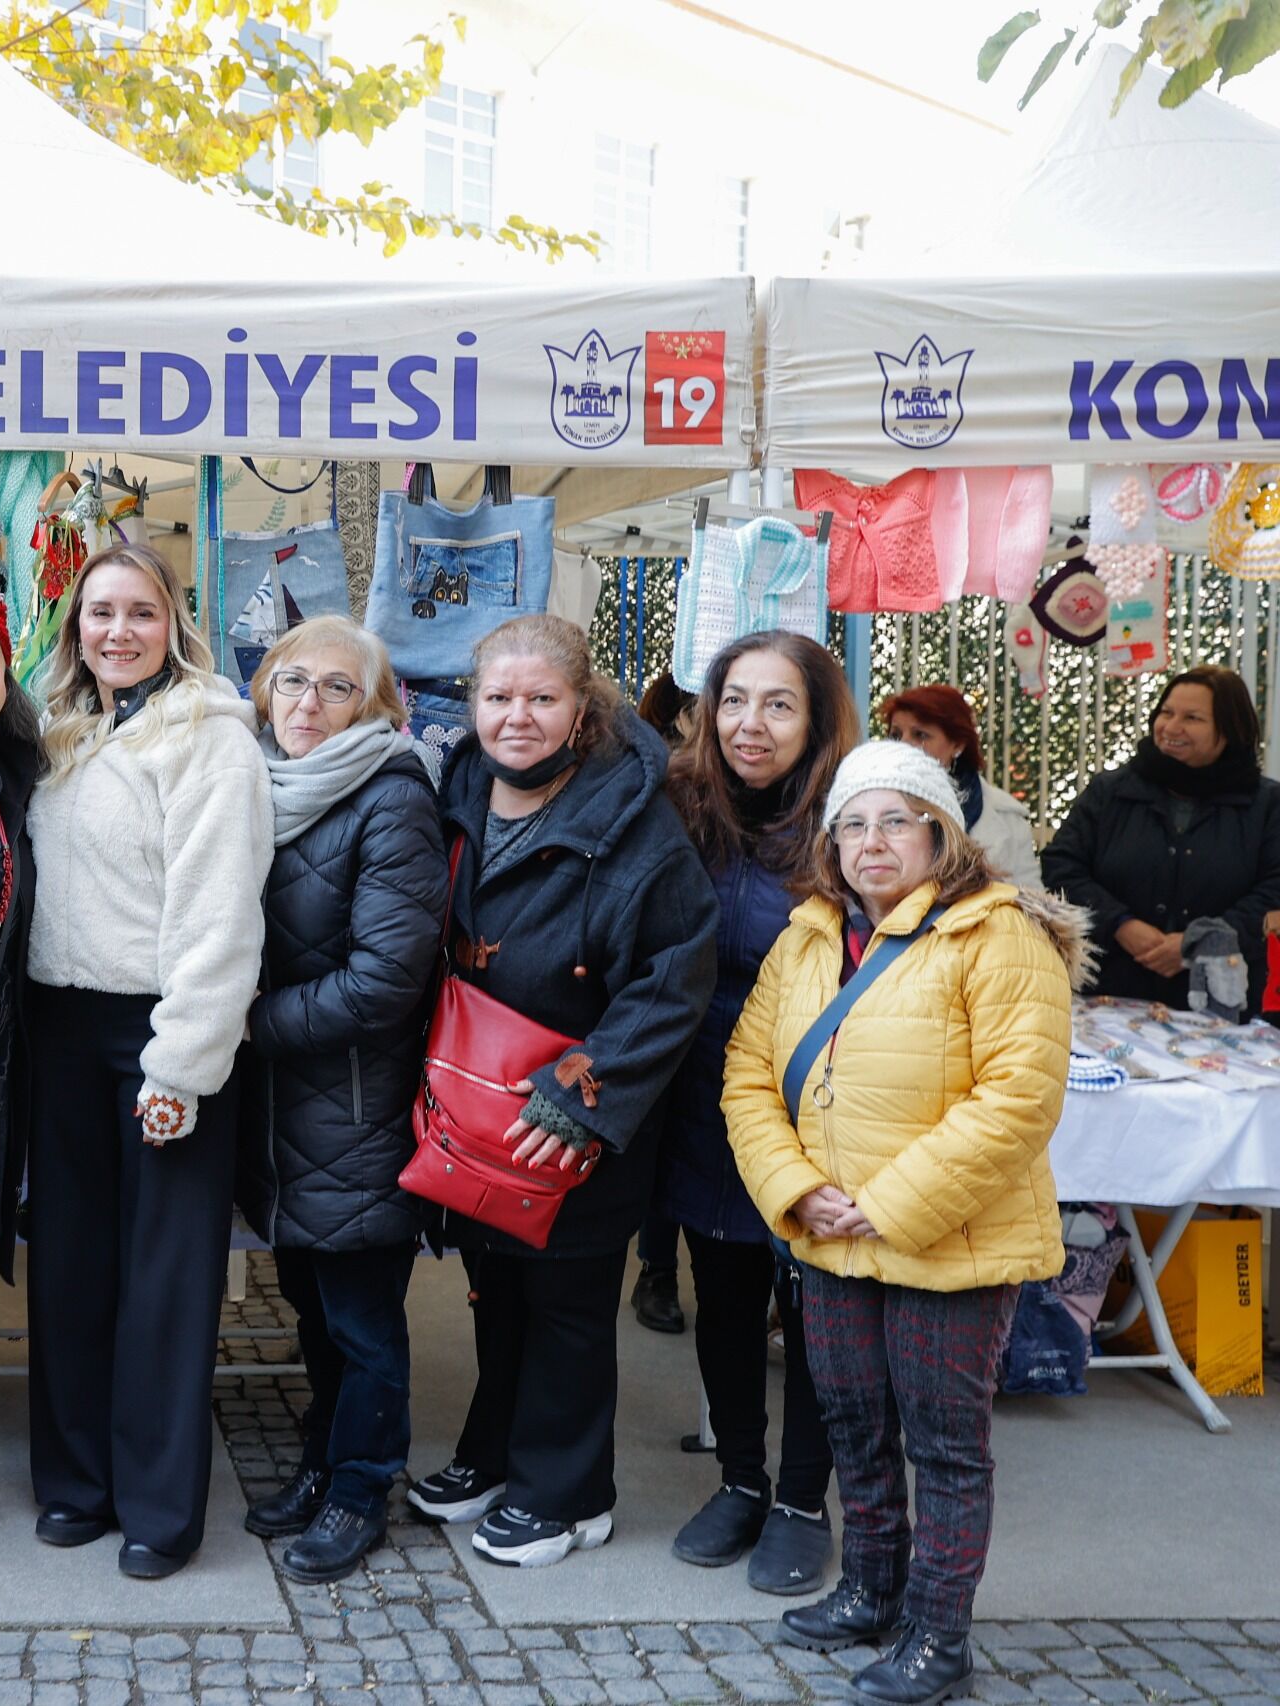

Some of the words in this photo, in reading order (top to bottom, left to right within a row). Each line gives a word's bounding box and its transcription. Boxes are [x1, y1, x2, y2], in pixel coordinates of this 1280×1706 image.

[653, 376, 716, 428] 19
[562, 423, 583, 441] KONAK
[1236, 1244, 1251, 1306] GREYDER
